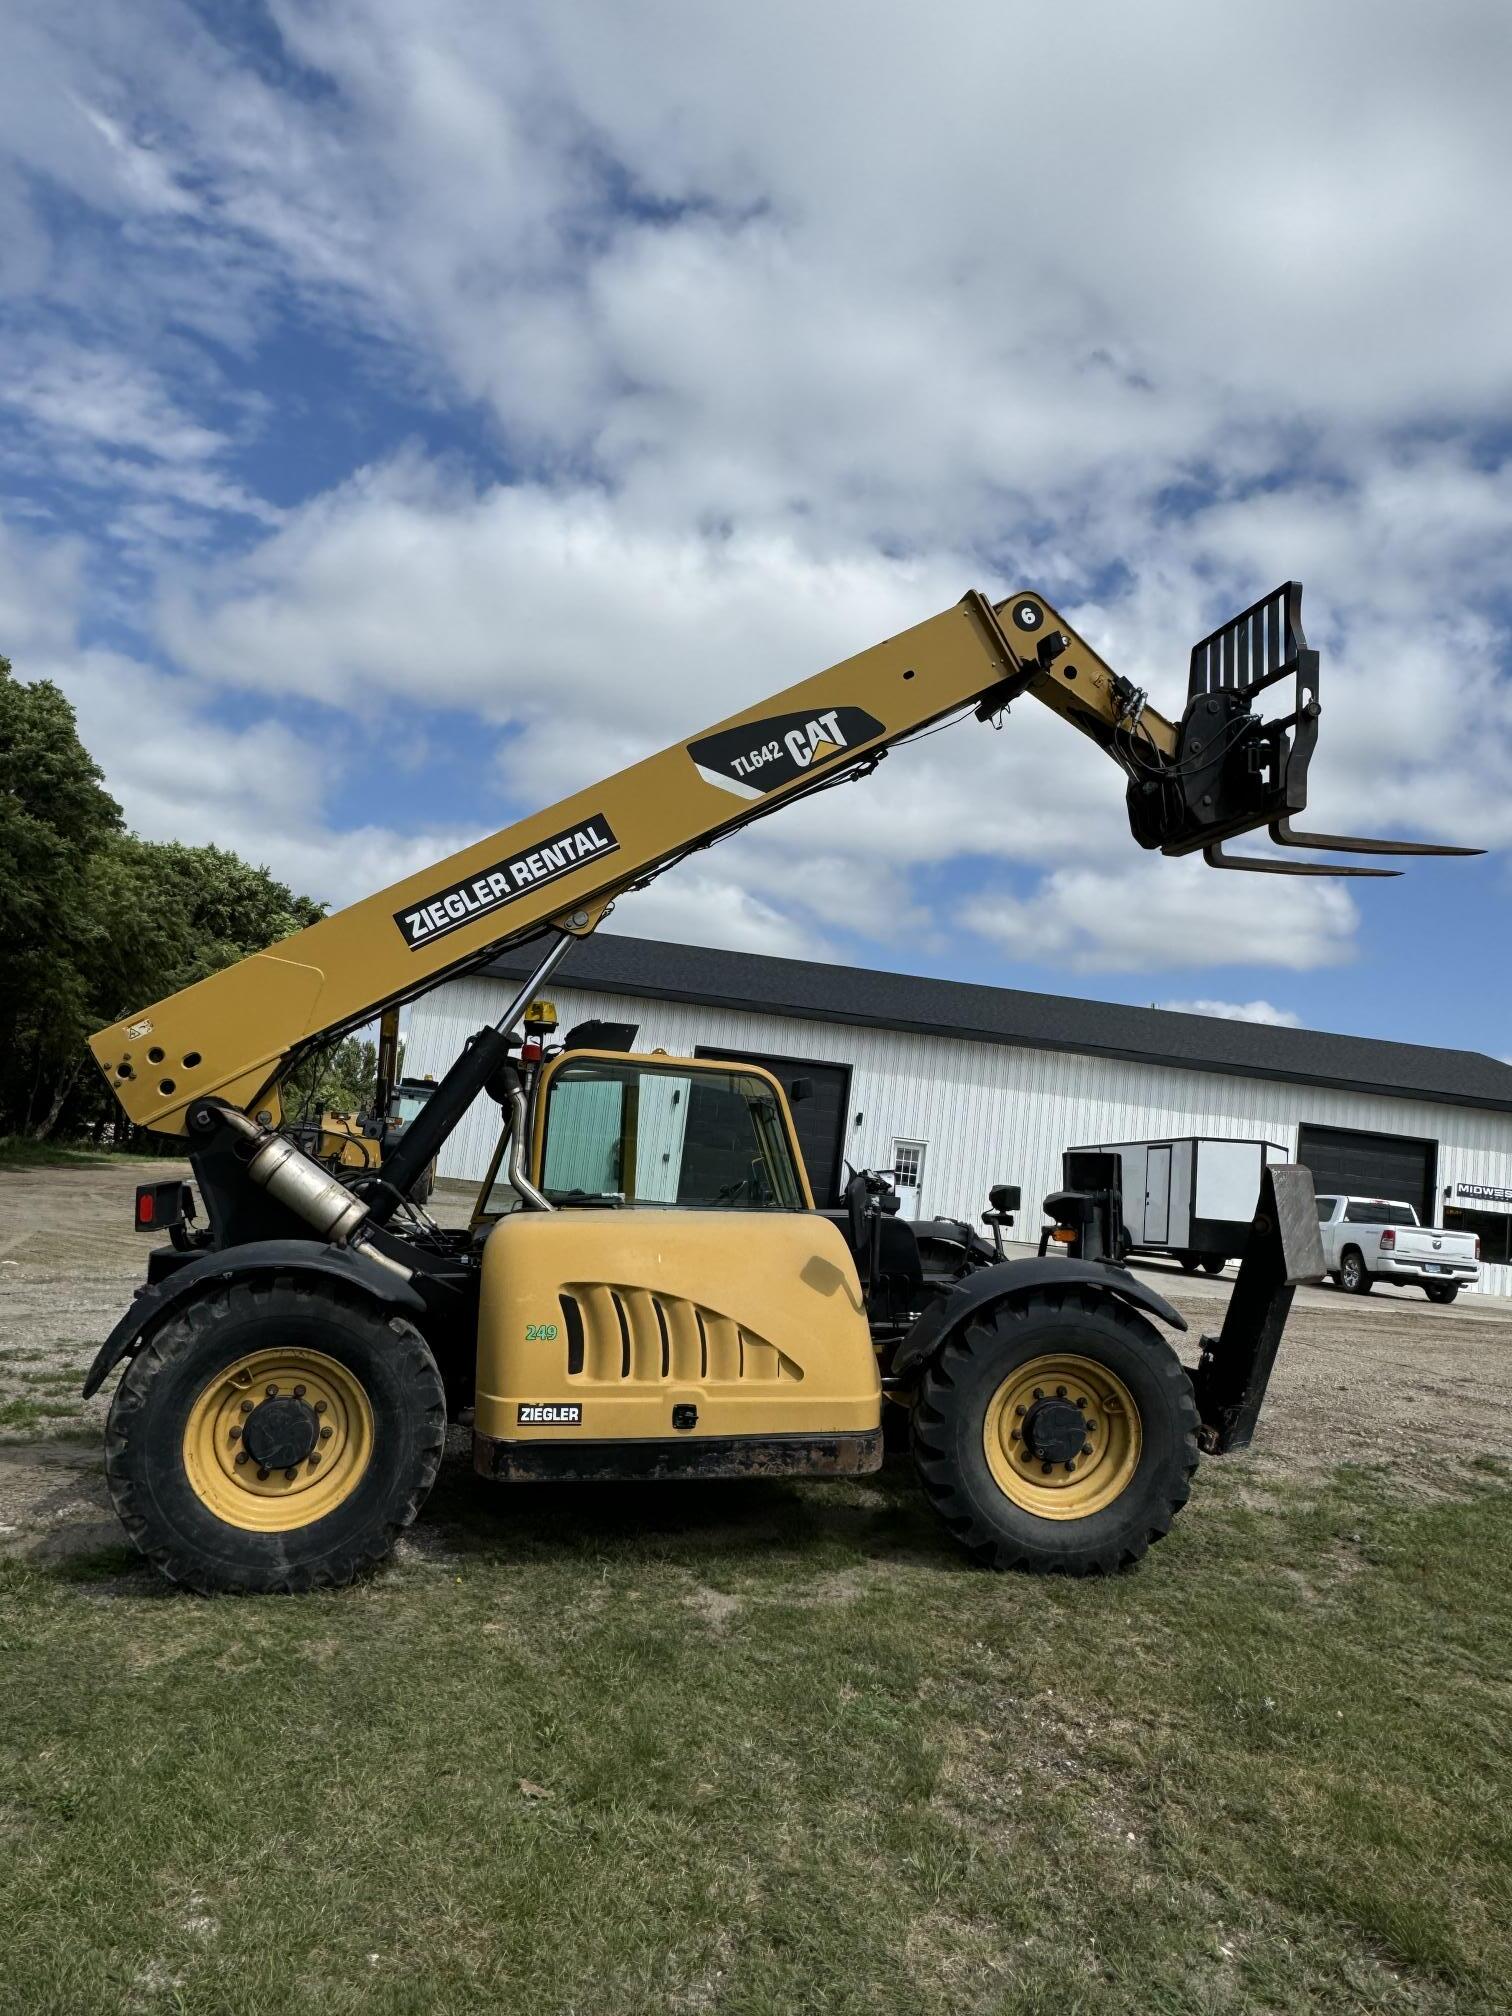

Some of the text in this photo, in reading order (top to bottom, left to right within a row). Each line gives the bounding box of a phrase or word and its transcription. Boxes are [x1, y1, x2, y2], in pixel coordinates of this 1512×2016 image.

[1021, 607, 1036, 625] 6
[730, 710, 848, 776] TL642 CAT
[404, 826, 609, 939] ZIEGLER RENTAL
[525, 1324, 558, 1341] 249
[520, 1407, 579, 1421] ZIEGLER
